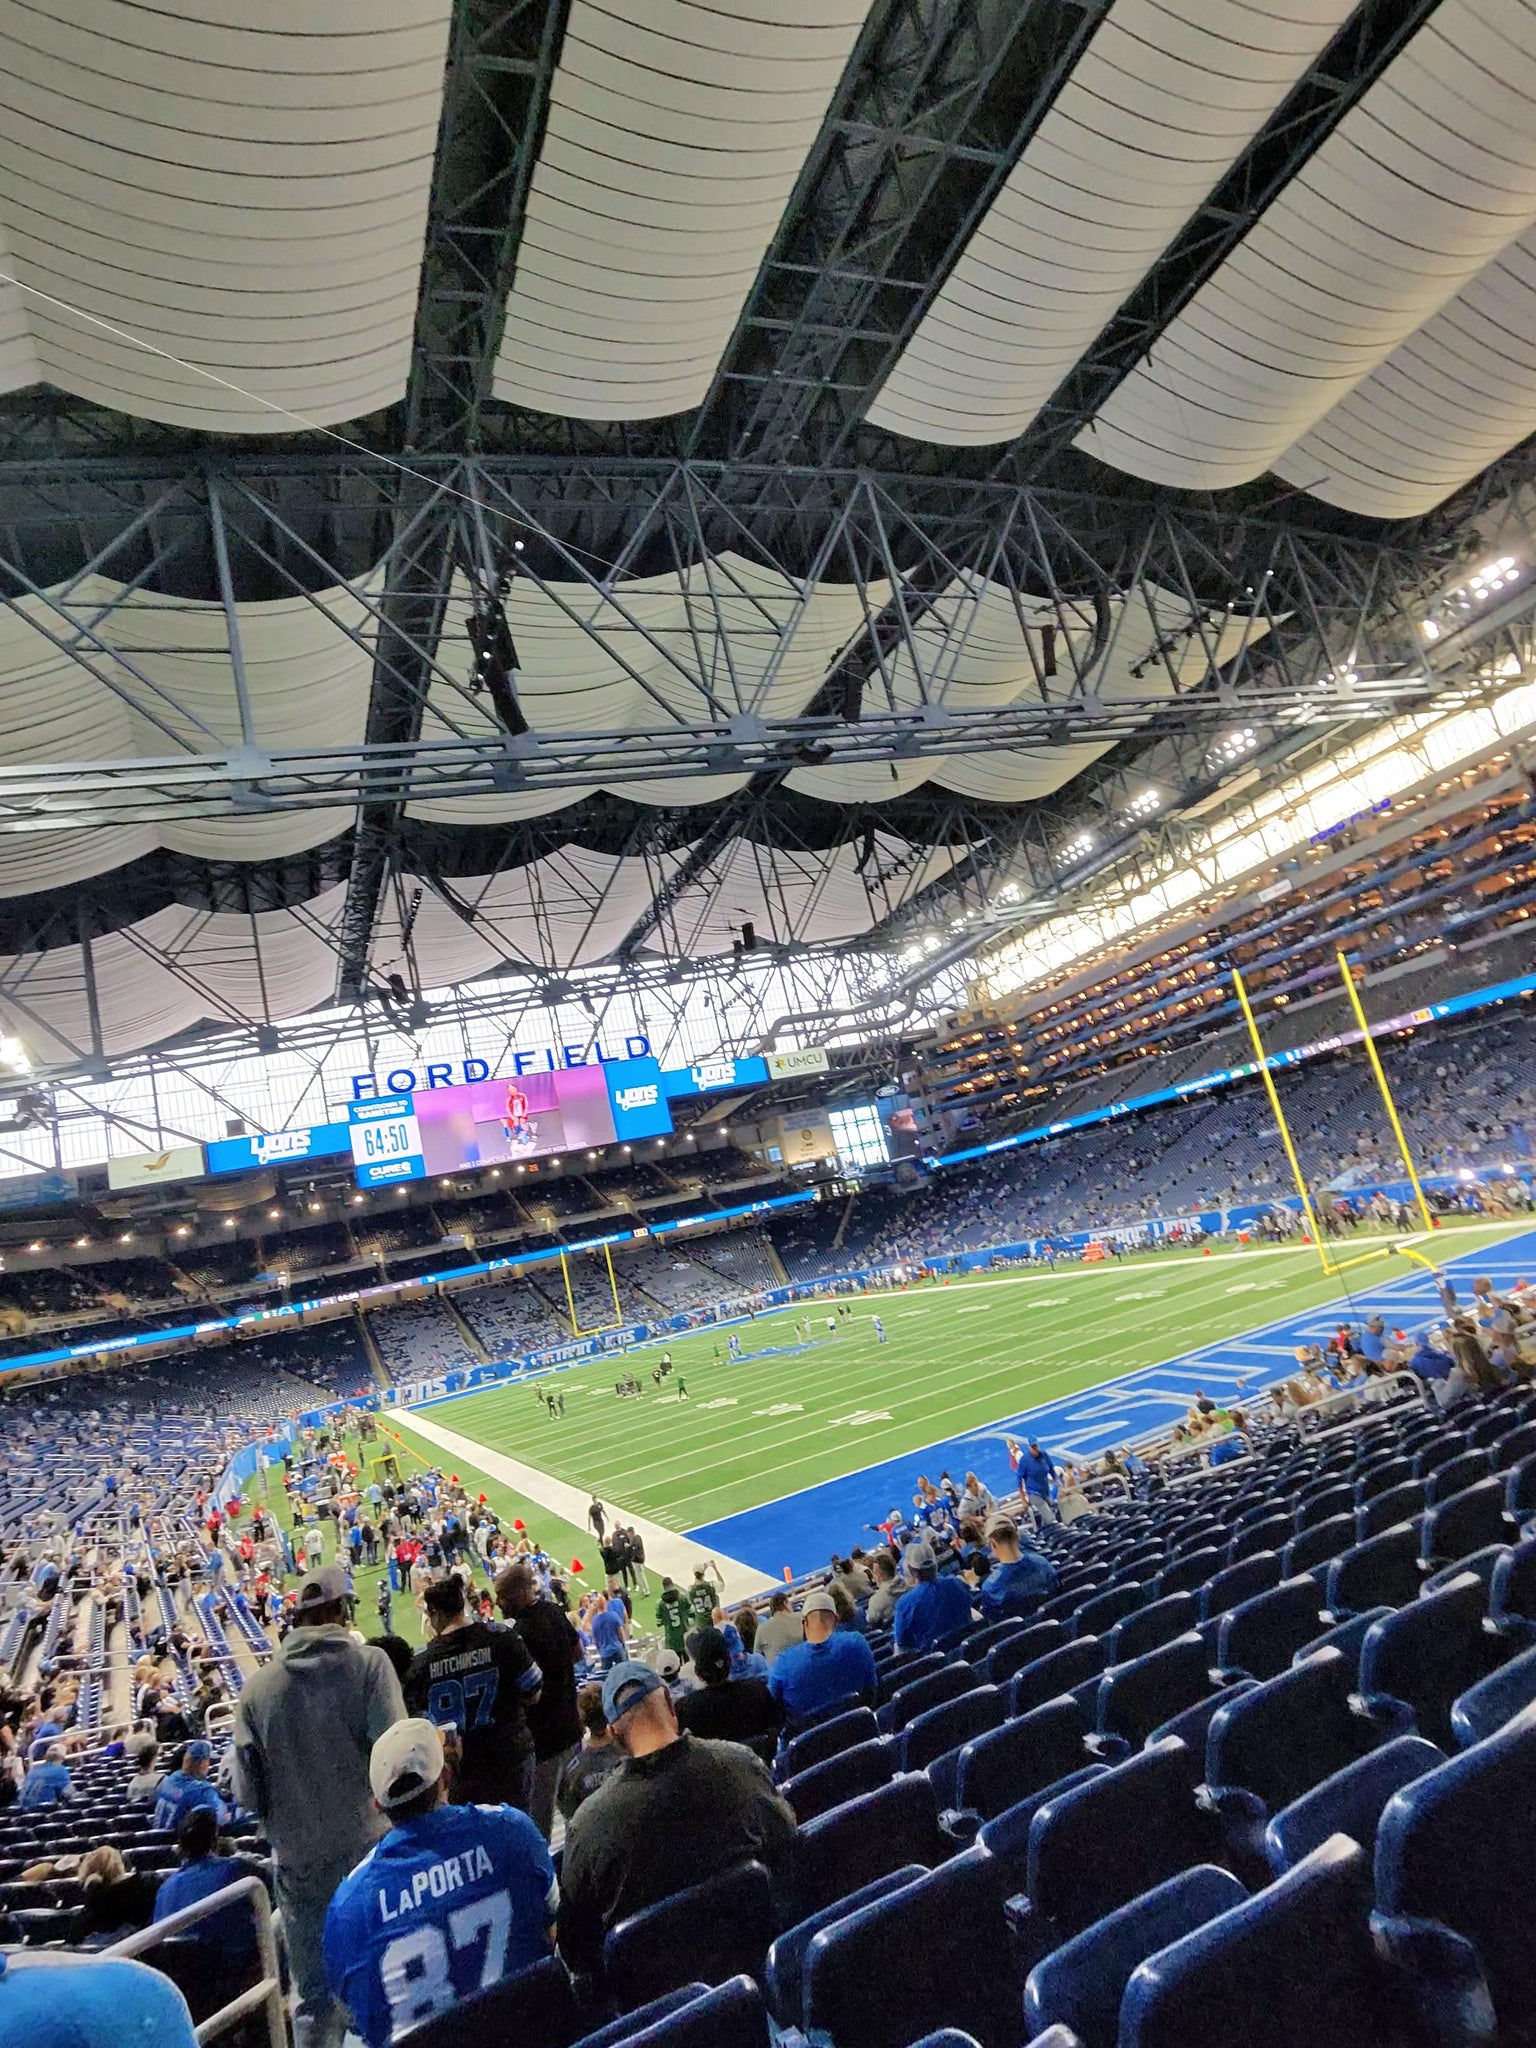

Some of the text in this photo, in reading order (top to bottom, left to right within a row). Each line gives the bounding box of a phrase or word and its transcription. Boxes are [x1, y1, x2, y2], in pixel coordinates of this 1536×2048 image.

[352, 1034, 650, 1100] FORD FIELD
[787, 1052, 823, 1069] UMCU
[364, 1124, 409, 1156] 64:50
[669, 1608, 681, 1627] 5
[429, 1647, 492, 1679] HUTCHINSON
[427, 1667, 500, 1733] 97
[379, 1887, 513, 2042] 87
